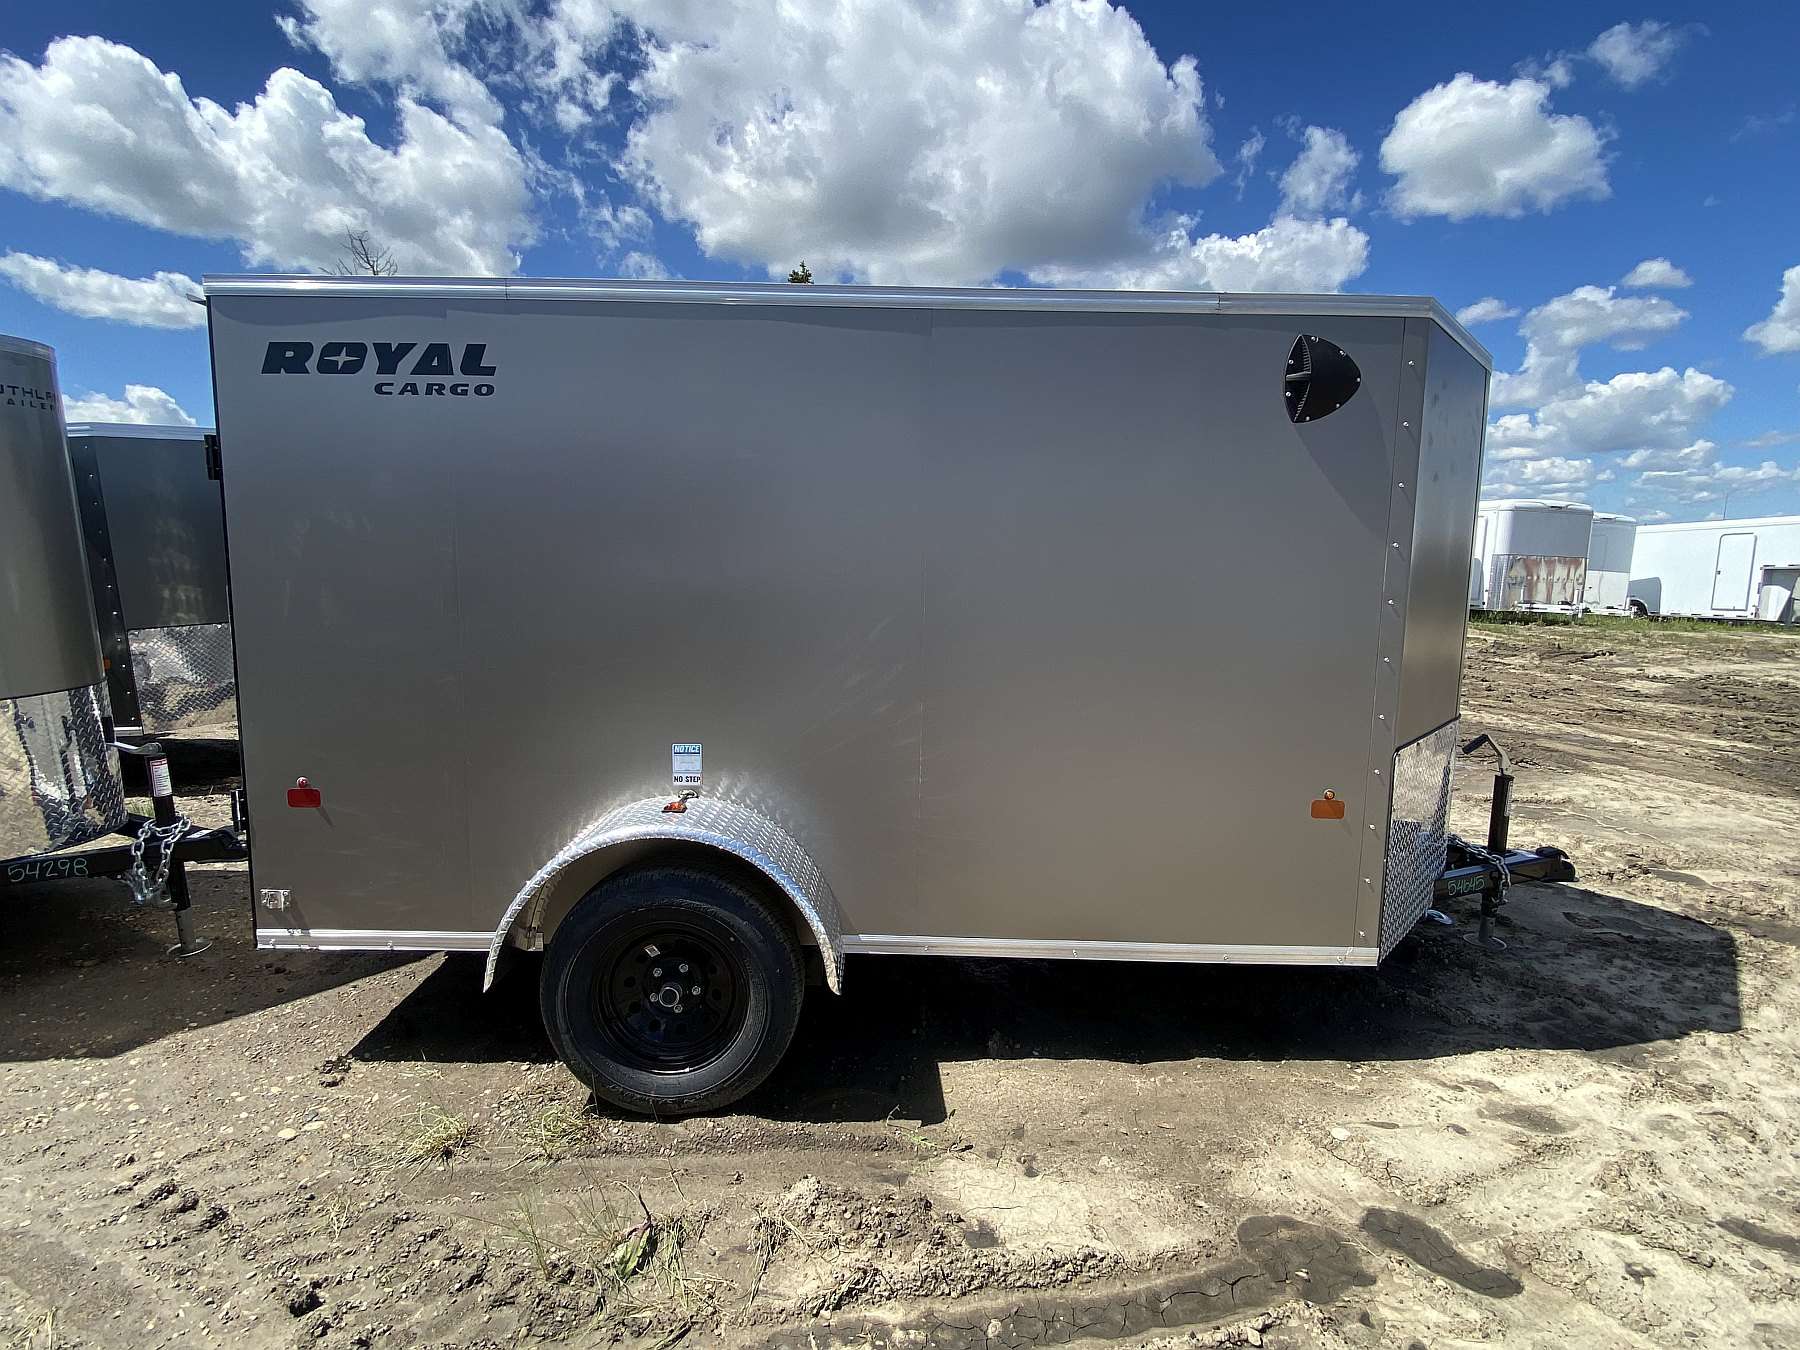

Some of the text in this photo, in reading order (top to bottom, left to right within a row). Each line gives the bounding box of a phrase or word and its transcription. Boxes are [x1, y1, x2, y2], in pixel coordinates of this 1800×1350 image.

[261, 341, 497, 376] ROYAL
[374, 382, 495, 396] CARGO
[674, 745, 700, 753] NOTICE
[673, 775, 701, 783] NO STEP
[7, 857, 89, 882] 54298
[1447, 875, 1485, 896] 54645
